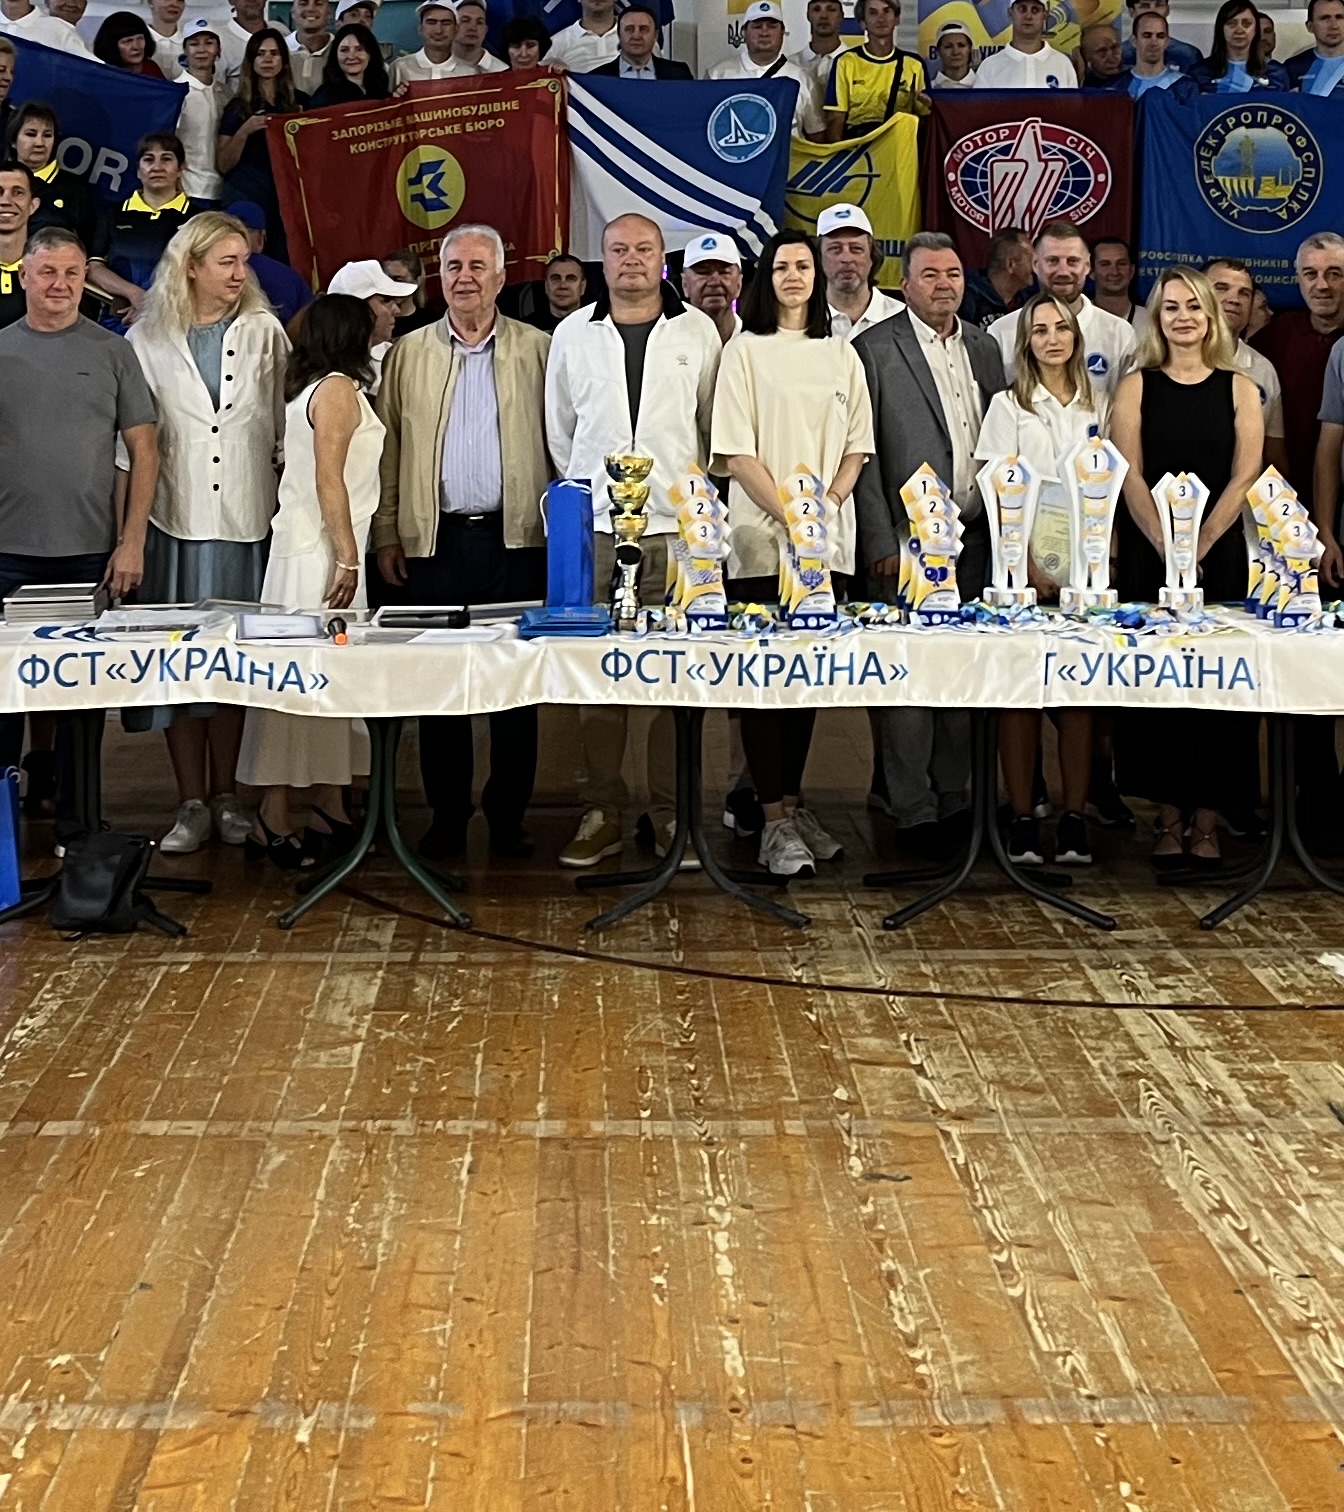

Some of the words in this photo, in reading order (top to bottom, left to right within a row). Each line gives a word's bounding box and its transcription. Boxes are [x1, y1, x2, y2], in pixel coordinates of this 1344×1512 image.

[465, 118, 506, 133] БЮРО
[952, 128, 1011, 163] МОТОР
[1065, 135, 1097, 160] СІЧ
[1199, 111, 1316, 220] УКРЕЛЕКТРОПРОФСПІЛКА
[949, 186, 986, 224] MOTOR
[1069, 198, 1098, 222] SICH
[1092, 454, 1098, 469] 1
[1007, 469, 1015, 483] 2
[1179, 485, 1186, 497] 3
[696, 502, 704, 515] 2
[802, 502, 810, 515] 2
[929, 500, 937, 514] 2
[1282, 503, 1290, 516] 2
[700, 525, 708, 538] 3
[806, 525, 814, 538] 3
[932, 522, 940, 534] 3
[1293, 525, 1301, 538] 3
[600, 645, 910, 688] ФСТ«УКРАЇНА»
